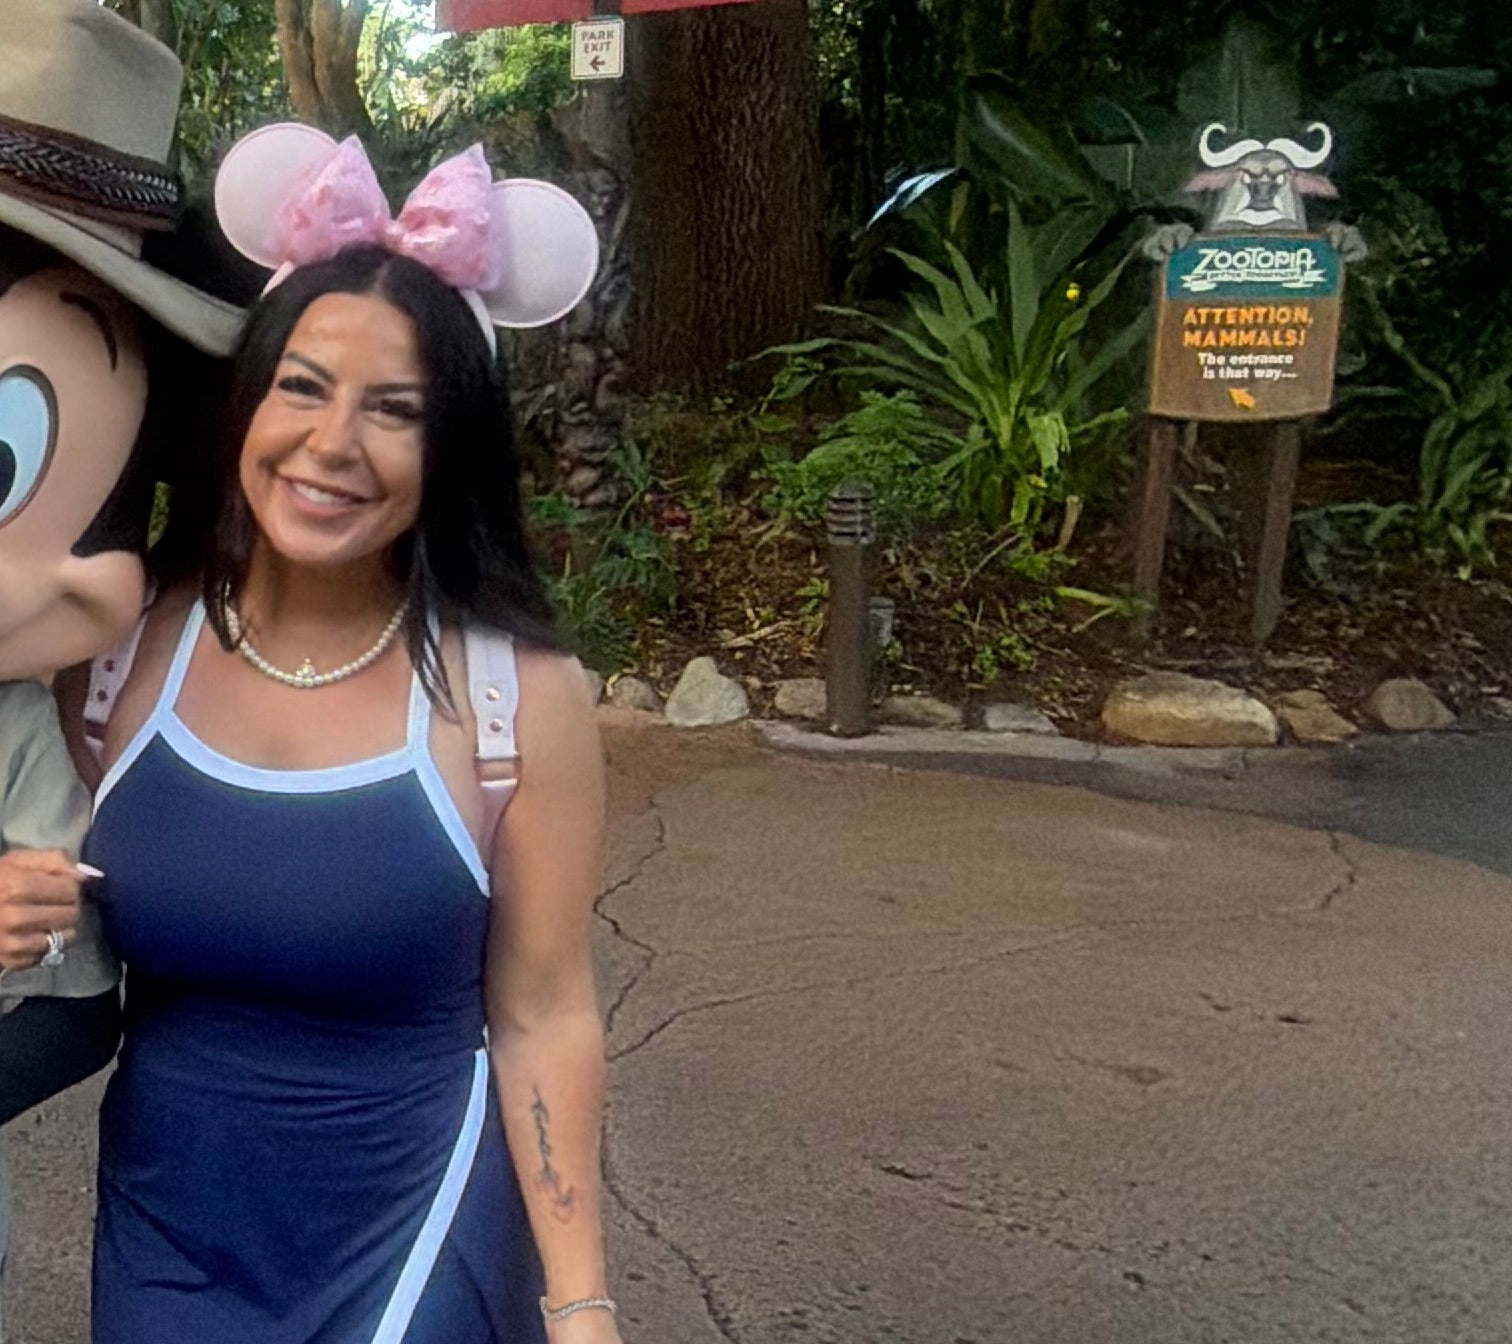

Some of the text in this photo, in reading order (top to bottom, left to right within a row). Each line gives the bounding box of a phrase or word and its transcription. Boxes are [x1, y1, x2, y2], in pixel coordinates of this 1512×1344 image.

[581, 30, 614, 42] PARK
[583, 41, 611, 54] EXIT
[1191, 247, 1316, 275] ZOOTOPIA
[1183, 306, 1314, 328] ATTENTION,
[1183, 328, 1306, 348] MAMMALS!
[1197, 352, 1294, 366] The entrance
[1218, 366, 1249, 379] that
